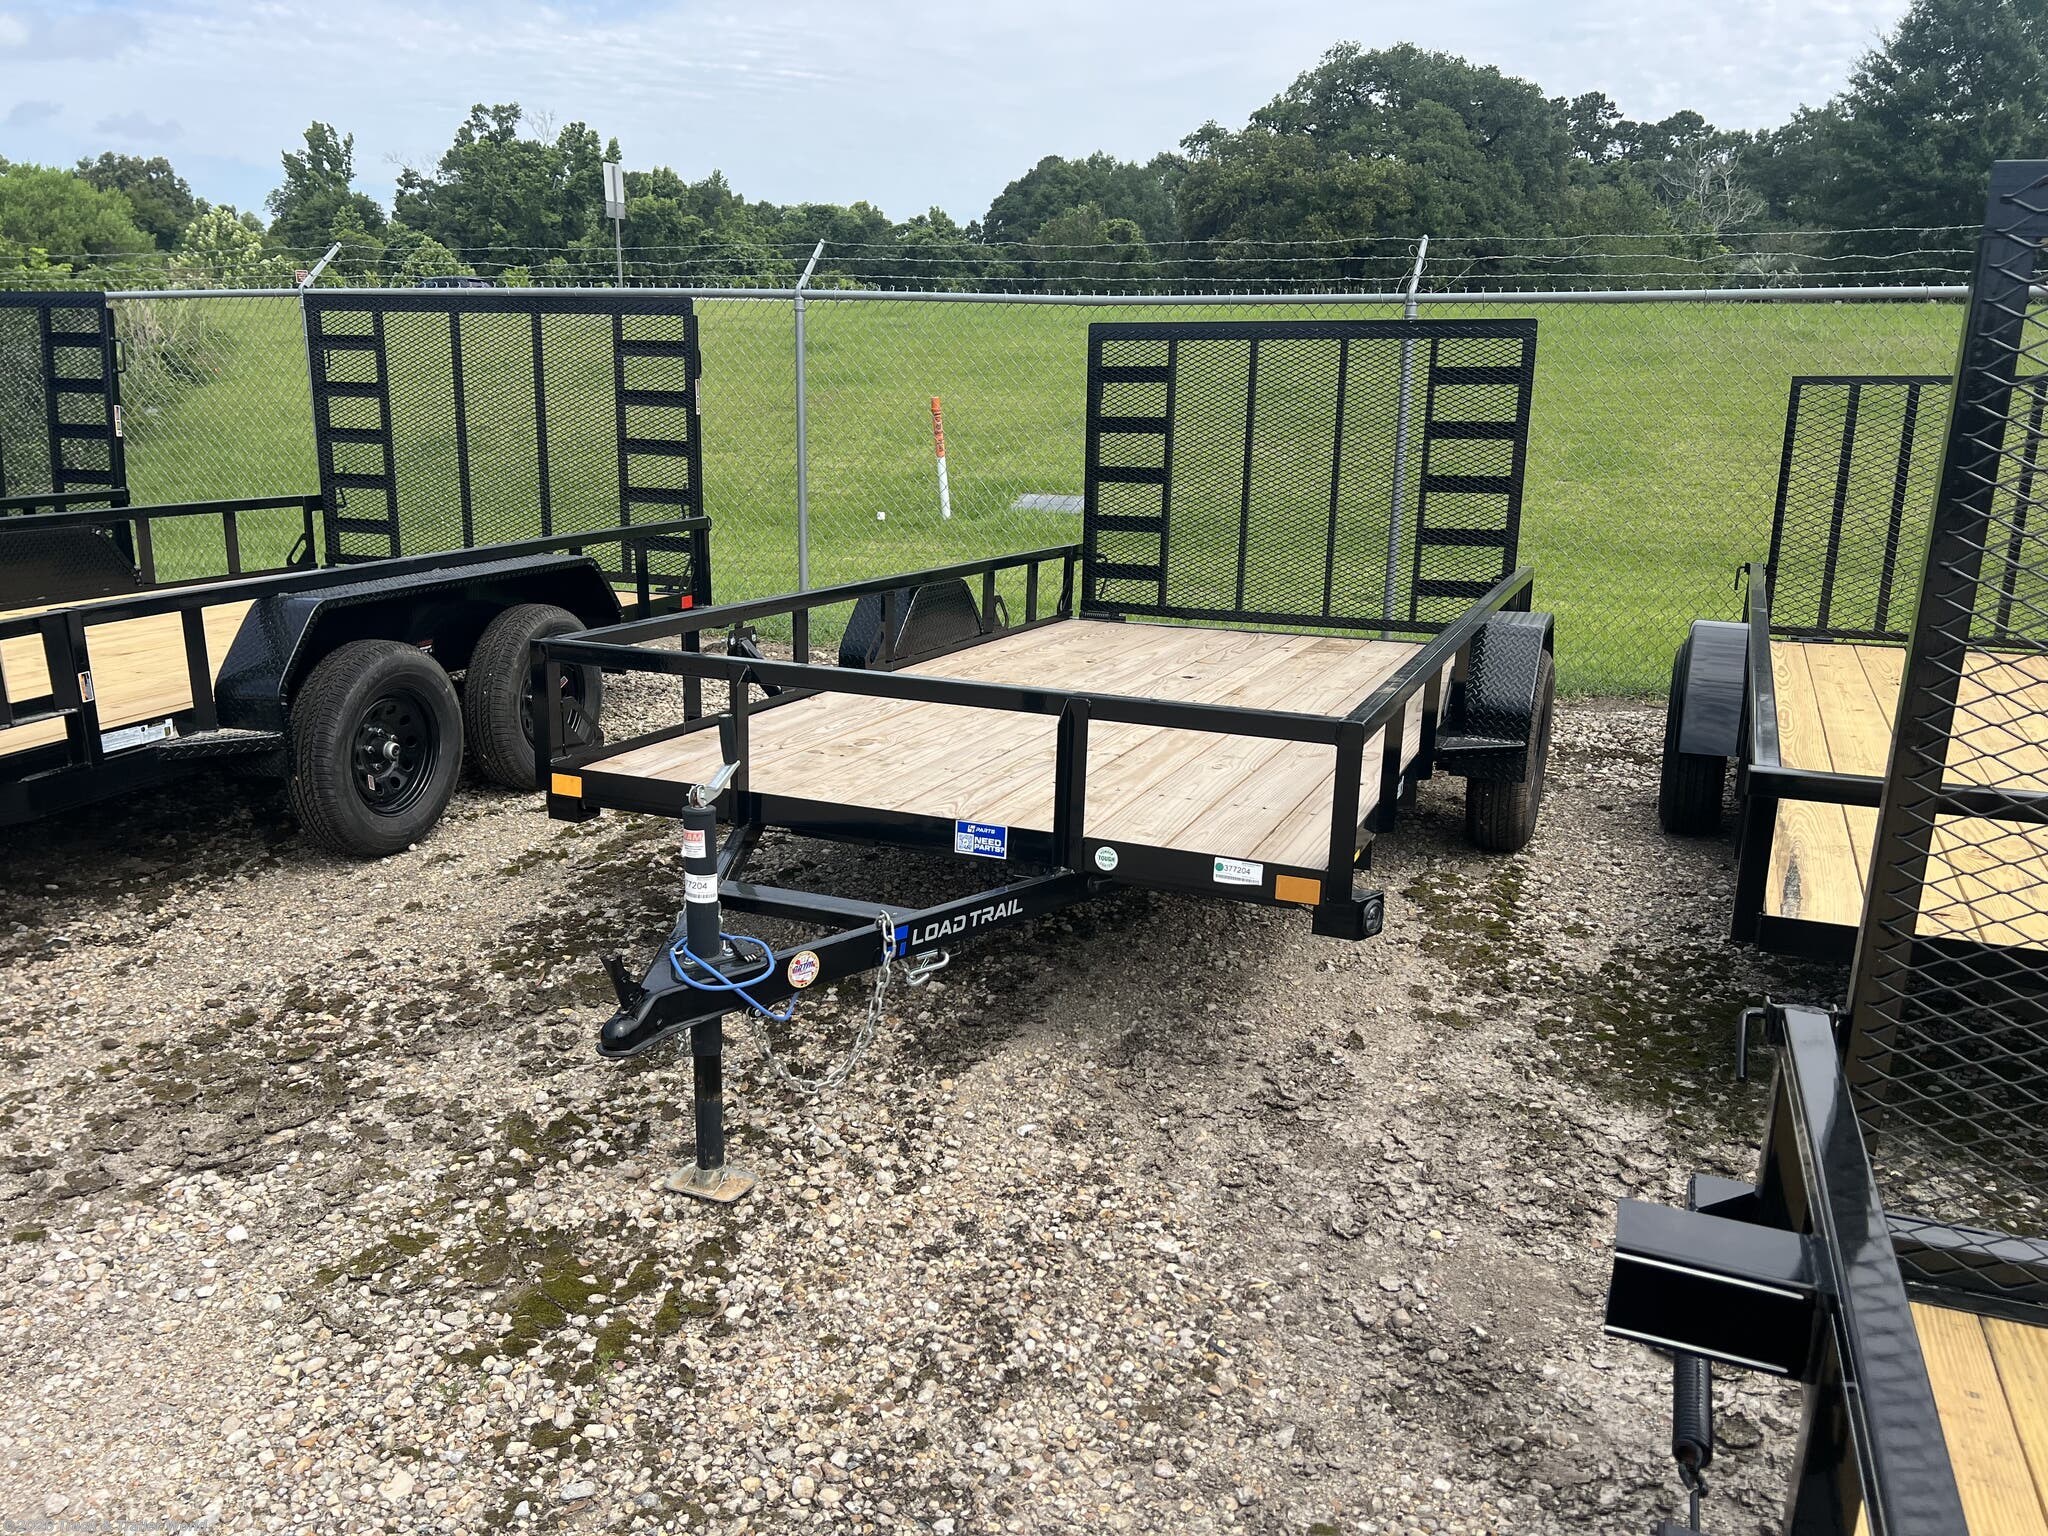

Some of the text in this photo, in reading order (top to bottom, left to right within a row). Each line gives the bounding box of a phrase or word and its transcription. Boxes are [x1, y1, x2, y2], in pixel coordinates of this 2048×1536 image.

[975, 836, 1002, 847] NEED
[974, 843, 1005, 853] PARTS?
[1223, 865, 1251, 874] 377204
[911, 898, 1024, 946] LOAD TRAIL
